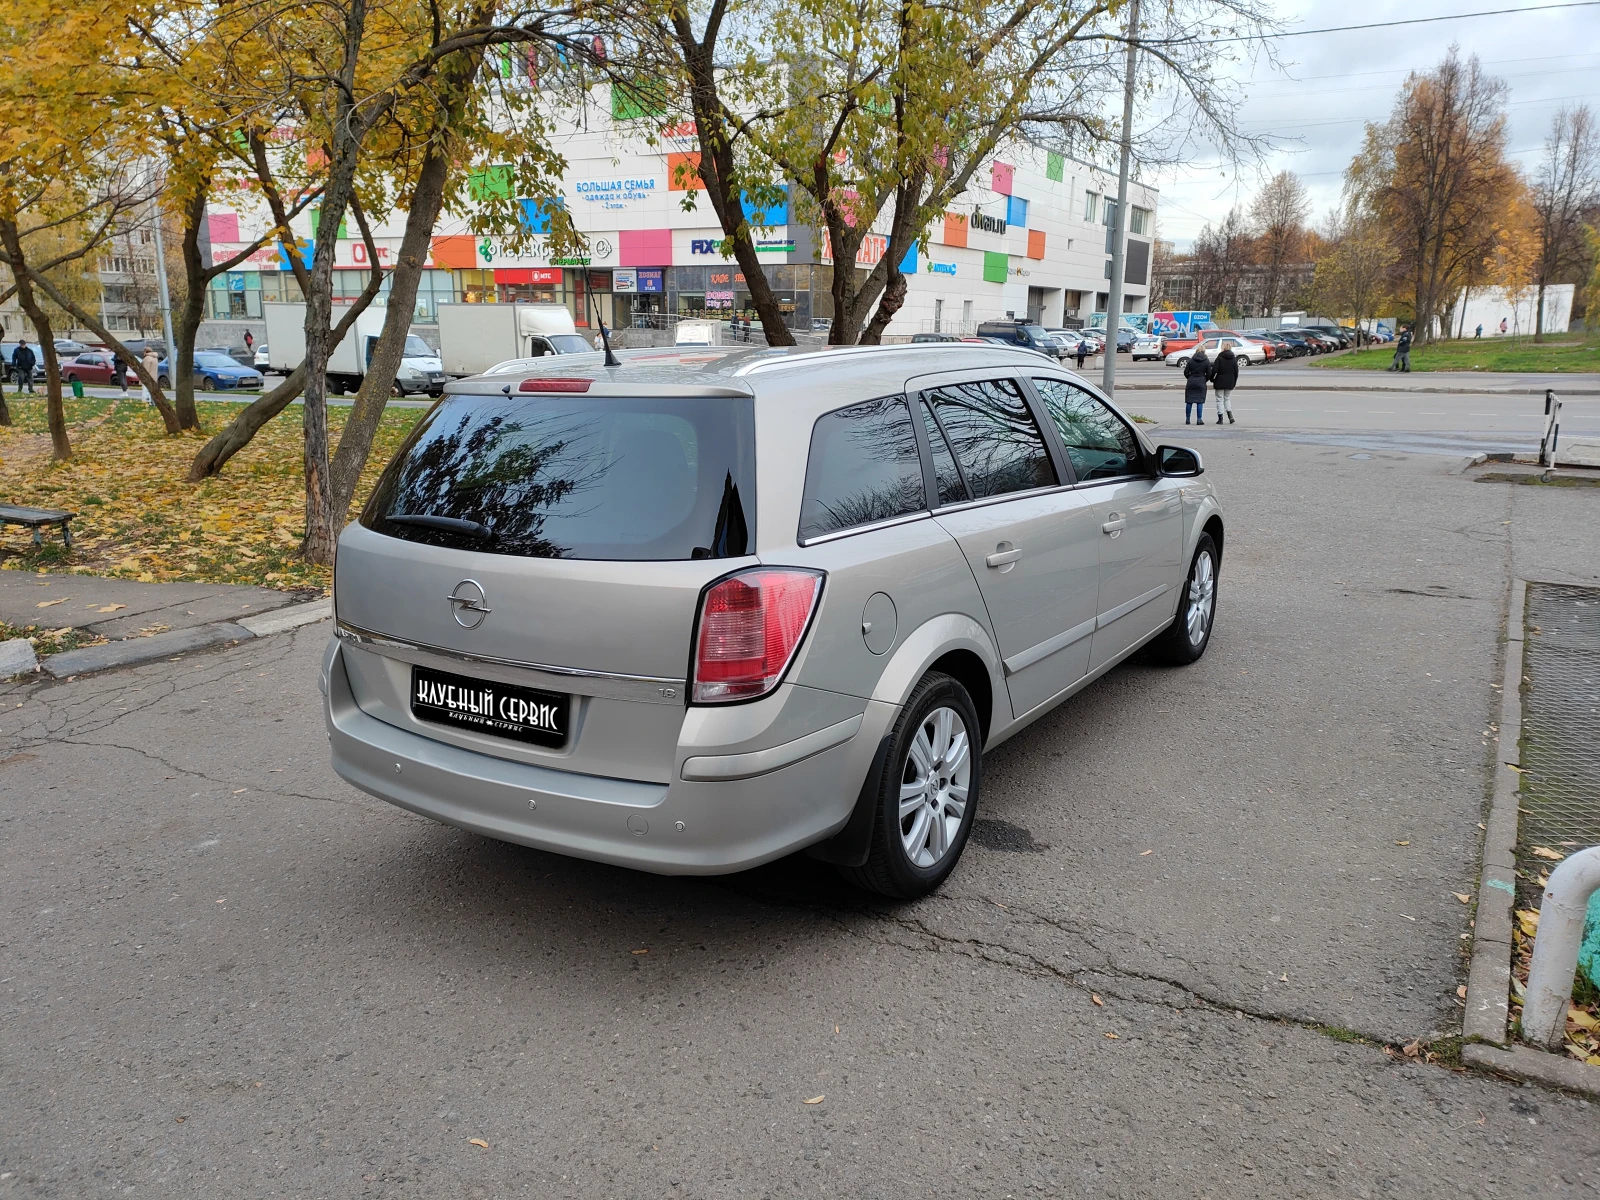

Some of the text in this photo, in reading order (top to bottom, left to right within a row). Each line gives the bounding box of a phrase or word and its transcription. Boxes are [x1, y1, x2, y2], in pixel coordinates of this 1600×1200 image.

[576, 179, 655, 192] БОЛЬШАЯ СЕМЬЯ
[585, 193, 614, 201] одежда
[623, 190, 646, 201] обувь
[971, 204, 1006, 235] divan.ru
[1153, 318, 1189, 334] OZON
[416, 679, 559, 730] КЛУБНЫЙ СЕРВИС
